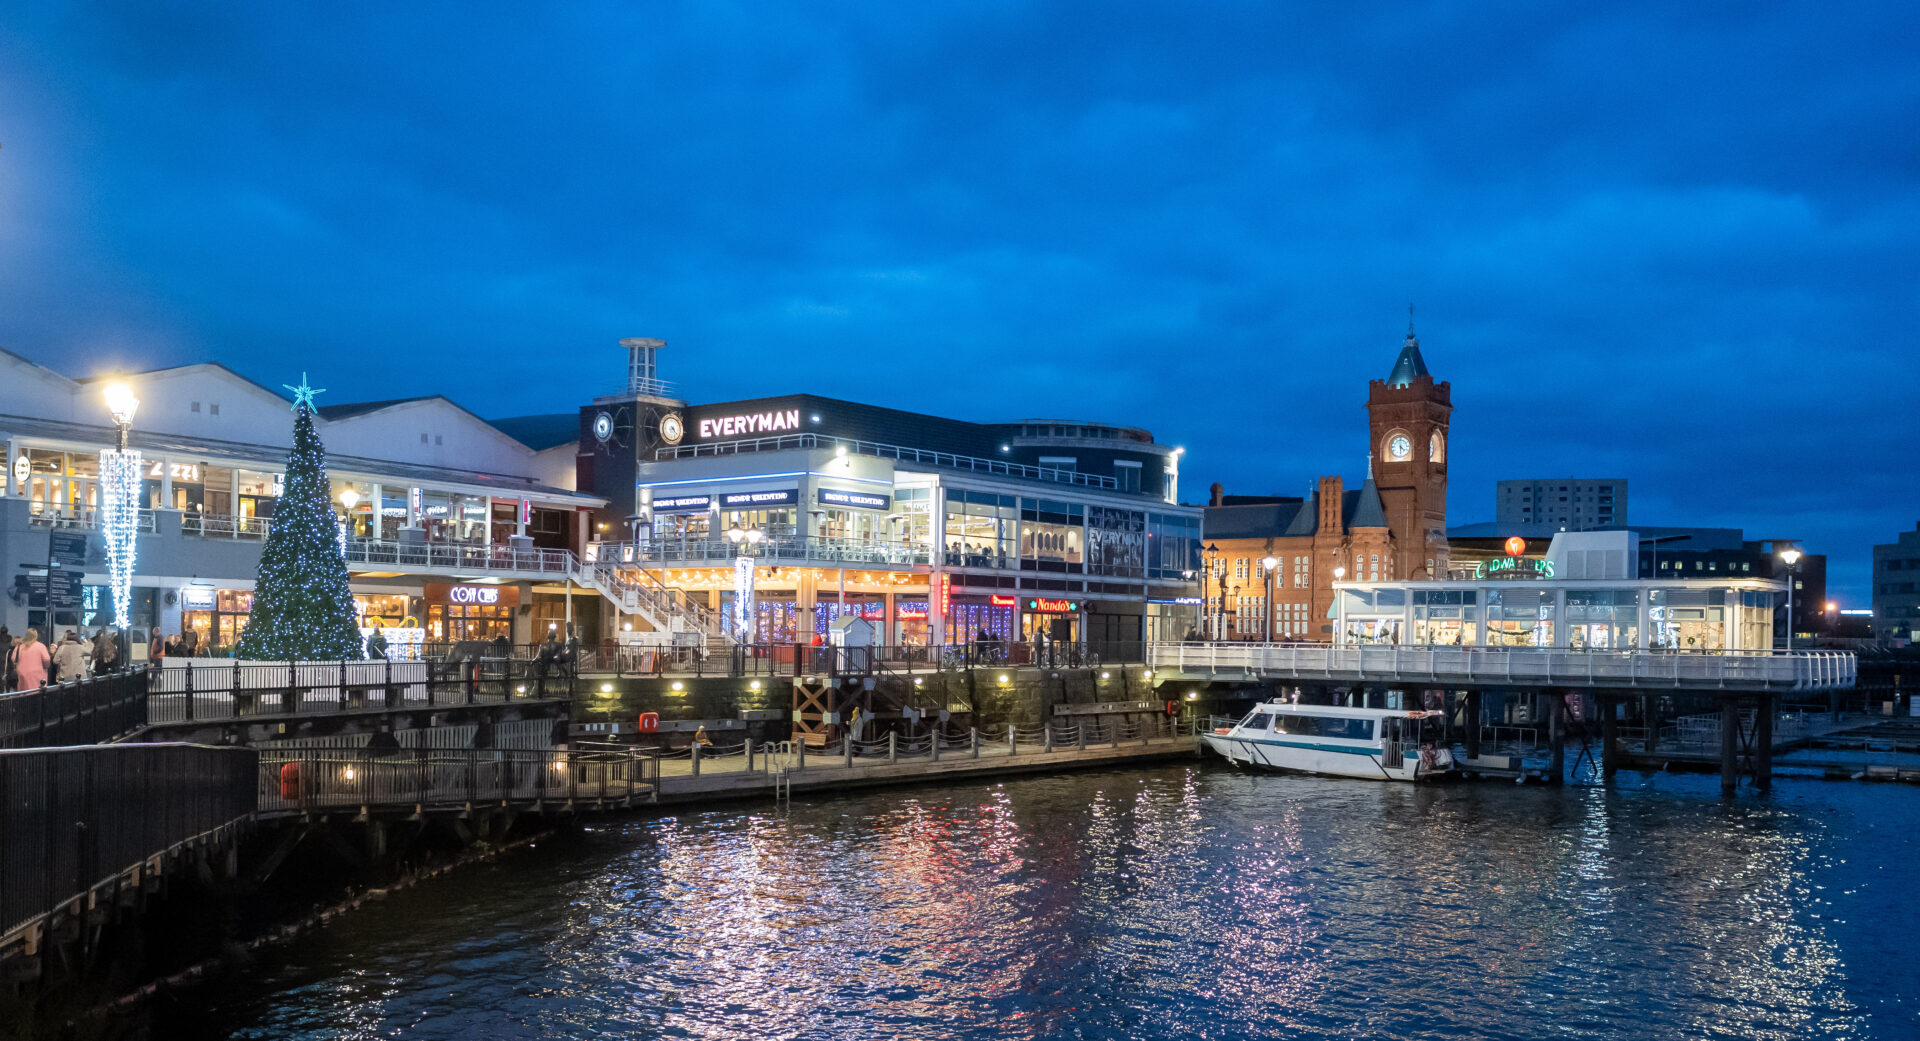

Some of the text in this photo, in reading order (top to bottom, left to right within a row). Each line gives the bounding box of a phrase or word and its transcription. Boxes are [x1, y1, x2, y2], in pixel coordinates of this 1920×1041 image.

[700, 409, 799, 437] EVERYMAN
[1089, 529, 1143, 545] EVERYMAN
[450, 587, 477, 603] COSY
[1037, 598, 1071, 612] Nando's
